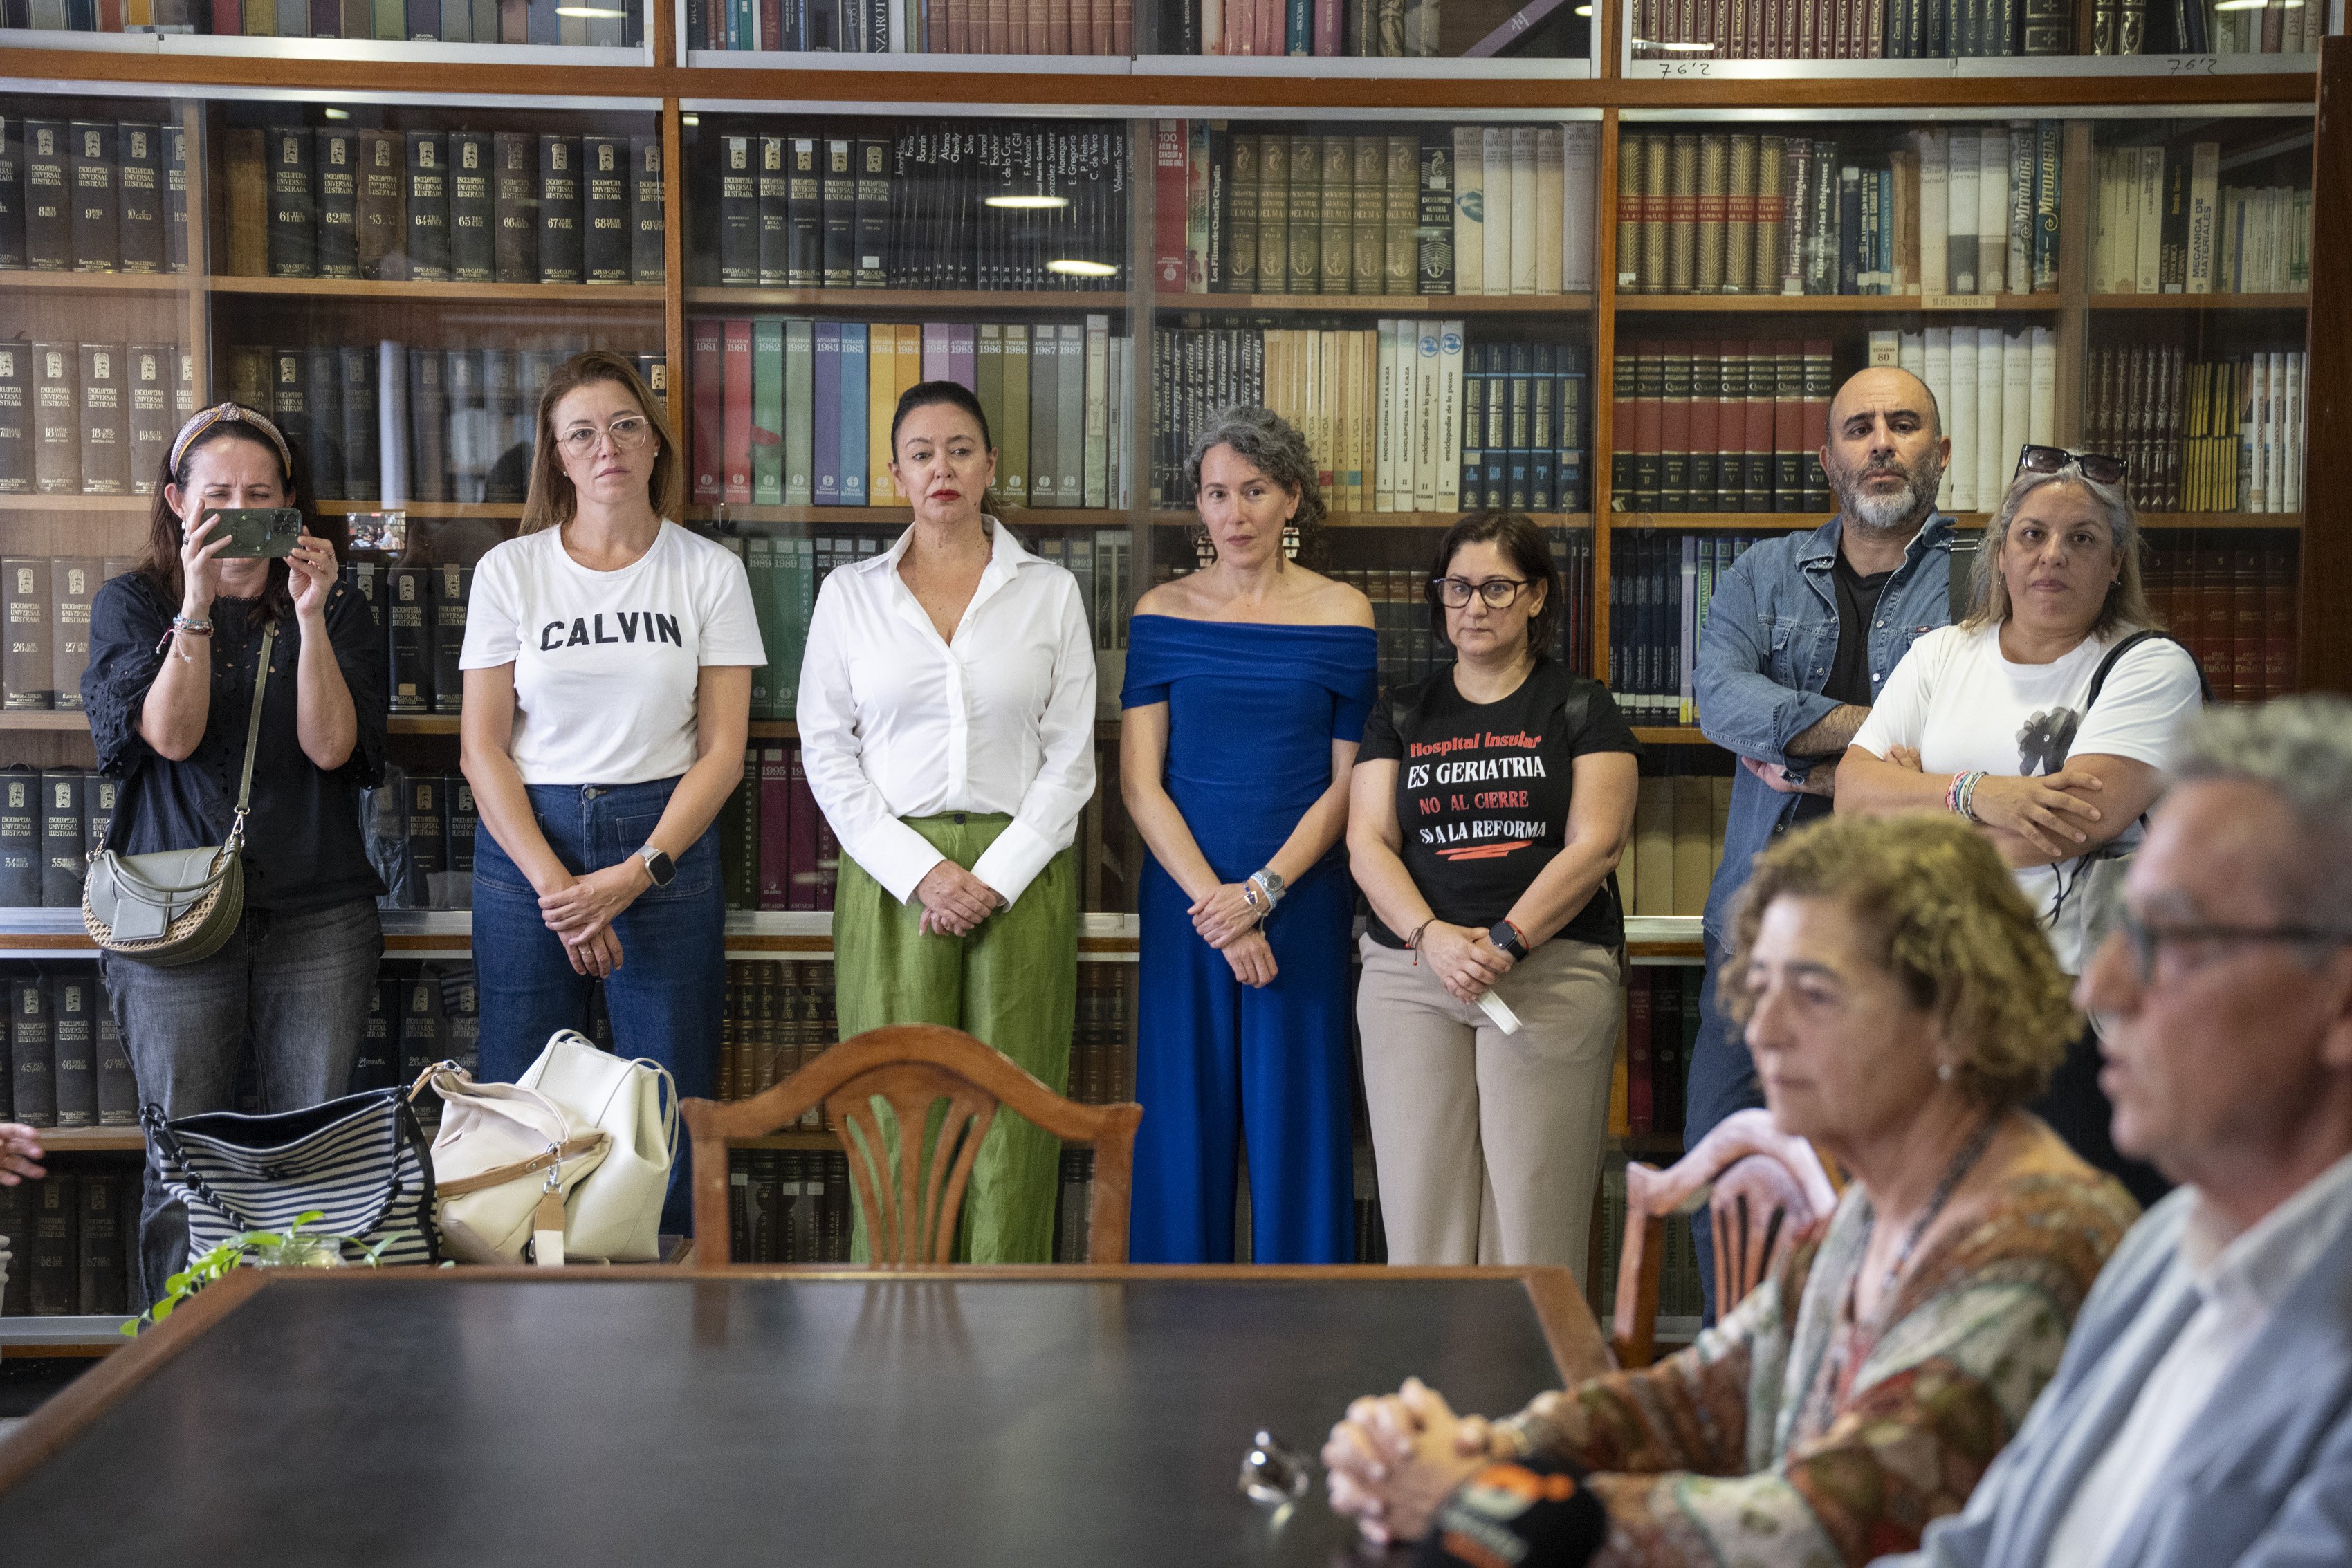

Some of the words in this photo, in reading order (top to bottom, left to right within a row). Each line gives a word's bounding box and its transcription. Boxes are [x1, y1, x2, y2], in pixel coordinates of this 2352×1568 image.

[1159, 133, 1176, 142] 100
[964, 134, 974, 154] Silva
[978, 134, 988, 158] Ismael
[1001, 136, 1011, 156] Cruz
[1080, 134, 1089, 162] Fleitas
[1090, 134, 1099, 154] Vera
[1114, 136, 1123, 156] Sanz
[990, 135, 999, 165] Escobar
[1058, 136, 1067, 174] Monagas
[1067, 135, 1078, 175] Gregorio
[1002, 158, 1011, 166] la
[1090, 156, 1099, 167] de
[125, 167, 154, 175] ENCICLOPEDIA
[1002, 167, 1011, 178] de
[1047, 164, 1056, 196] onzález
[1213, 165, 1221, 198] Chaplin
[1794, 158, 1807, 205] Religiones
[1819, 163, 1830, 210] Religiones
[2196, 198, 2203, 213] DE
[39, 207, 44, 216] 8
[127, 209, 135, 219] 10
[1818, 211, 1826, 224] las
[595, 218, 606, 229] 68
[1794, 221, 1802, 232] de
[1212, 230, 1219, 241] de
[1818, 225, 1826, 236] de
[2201, 206, 2211, 278] MATERIALES
[1792, 234, 1801, 275] Historia
[1816, 237, 1825, 278] Historia
[696, 343, 717, 351] 1981
[727, 344, 748, 352] 1981
[816, 343, 839, 352] 1983
[842, 344, 864, 353] 1983
[1877, 353, 1889, 362] 80
[1384, 387, 1389, 396] LA
[1384, 398, 1389, 408] DE
[1423, 407, 1429, 417] de
[1446, 404, 1452, 414] de
[45, 427, 53, 437] 18
[1444, 416, 1453, 462] enciclopedia
[748, 559, 771, 568] 1989
[540, 611, 682, 652] CALVIN
[1485, 731, 1541, 748] Insular
[762, 766, 786, 775] 1995
[1408, 764, 1430, 789] ES
[1436, 756, 1546, 784] GERIATRIA
[1420, 797, 1440, 815] NO
[1451, 794, 1469, 811] AL
[1474, 791, 1529, 809] CIERRE
[1436, 826, 1446, 843] A
[1448, 822, 1468, 842] LA
[1473, 820, 1546, 838] REFORMA
[51, 858, 62, 867] 35
[62, 1060, 71, 1069] 46
